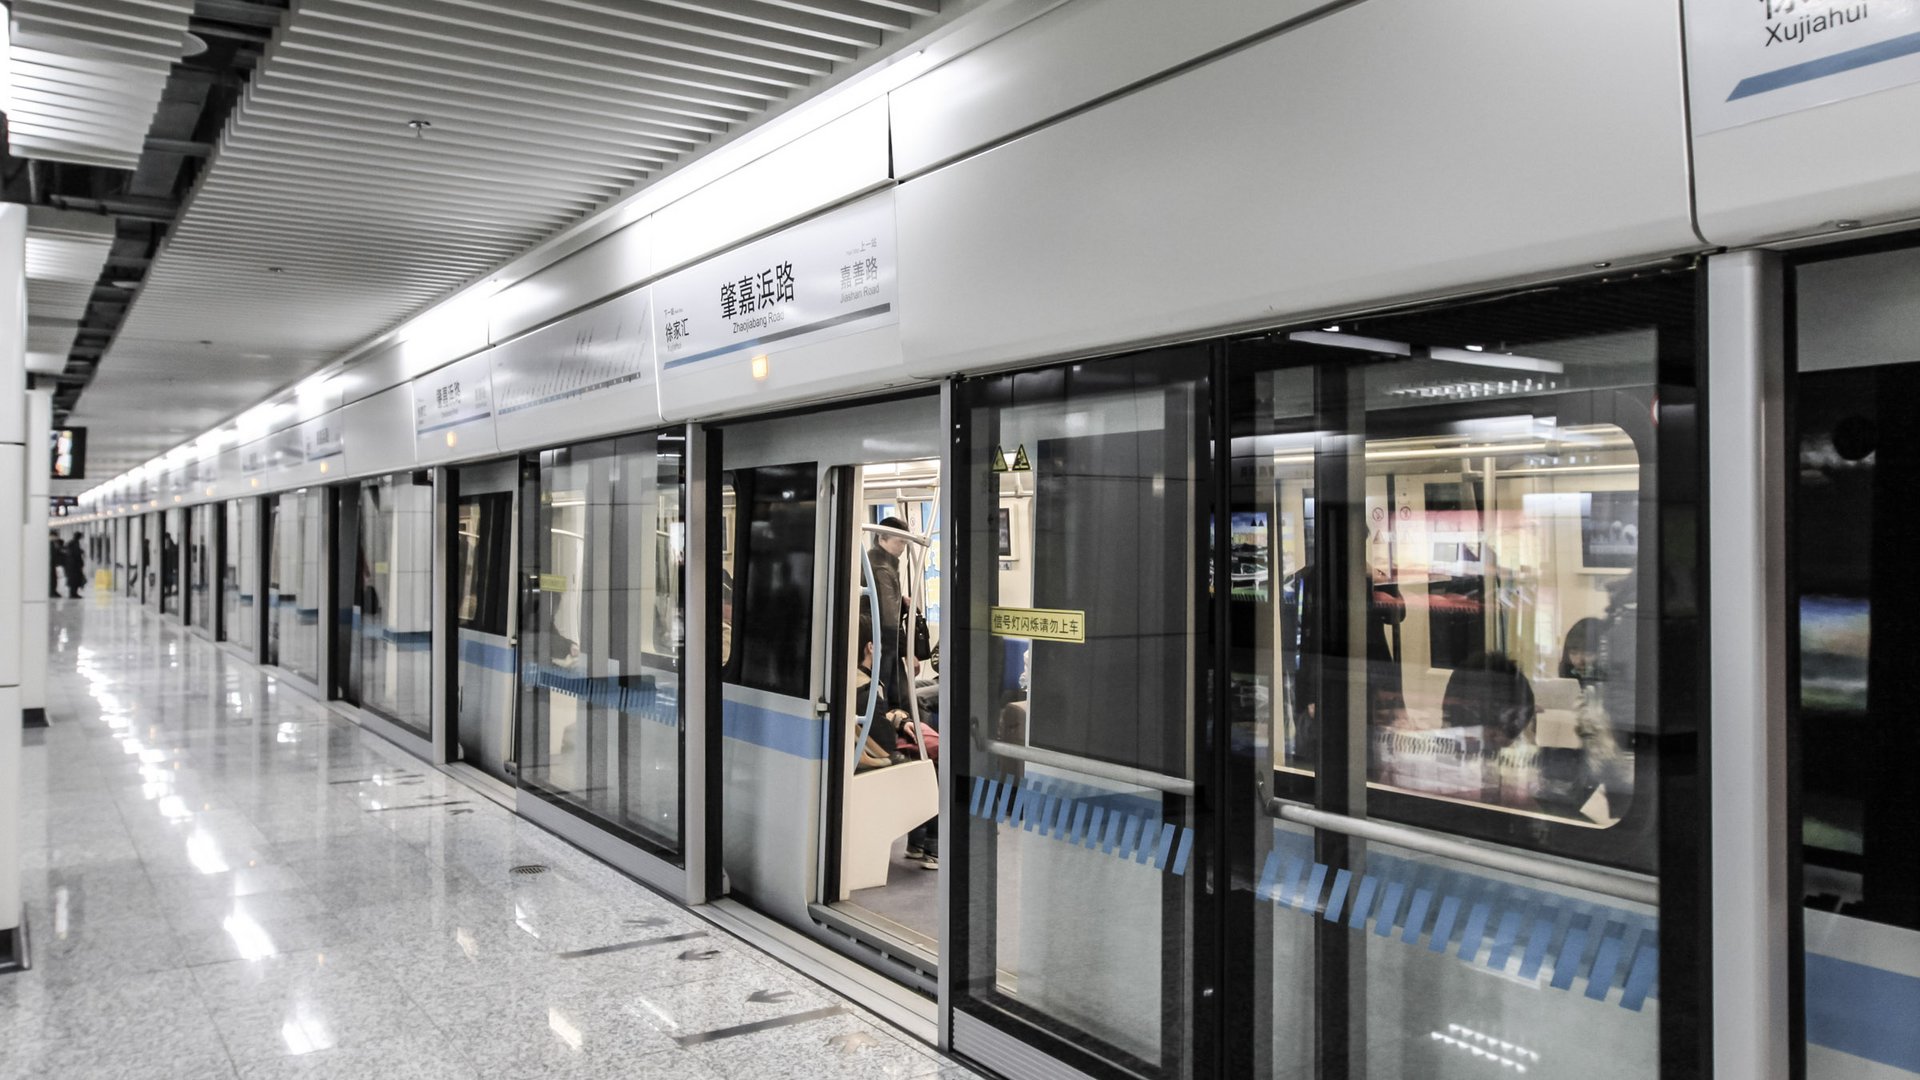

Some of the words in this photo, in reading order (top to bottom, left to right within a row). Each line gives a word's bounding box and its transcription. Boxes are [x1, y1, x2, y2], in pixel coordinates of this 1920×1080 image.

[1765, 3, 1868, 47] Xujiahui
[840, 256, 878, 289] 嘉善路
[720, 260, 795, 320] 肇嘉浜路
[840, 290, 862, 304] Jiashan
[863, 284, 880, 297] Road
[665, 318, 690, 343] 徐家汇
[733, 317, 768, 335] Zhaojiabang
[993, 614, 1079, 635] 信号灯闪烁请勿上车
